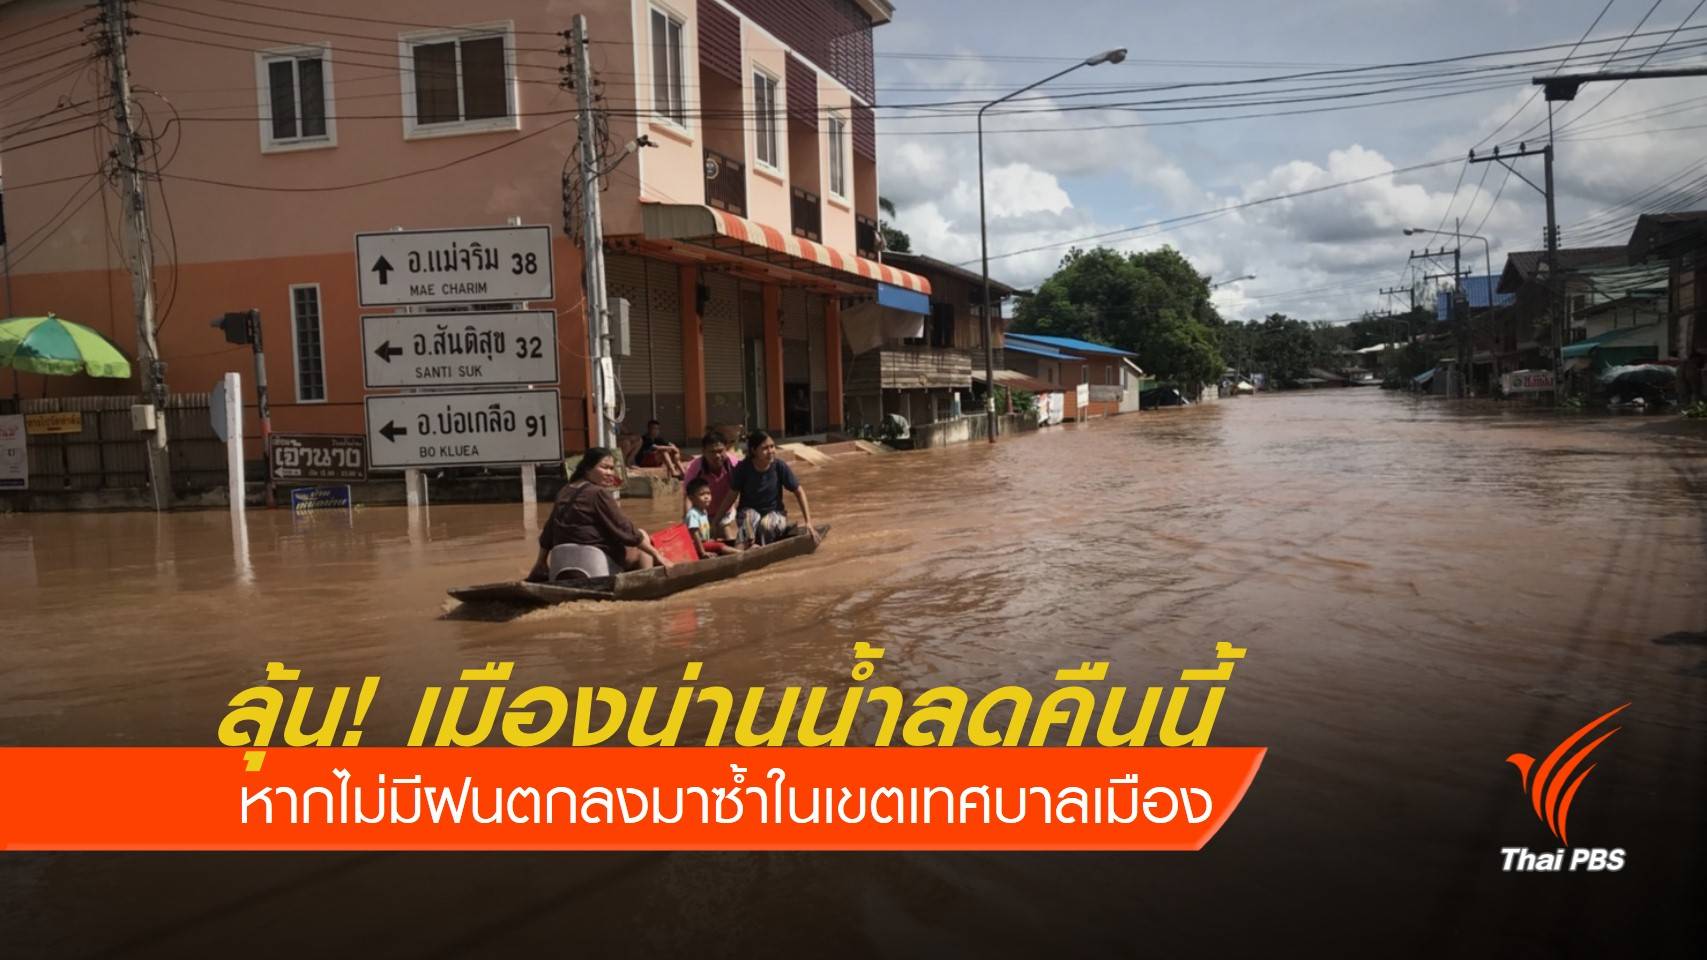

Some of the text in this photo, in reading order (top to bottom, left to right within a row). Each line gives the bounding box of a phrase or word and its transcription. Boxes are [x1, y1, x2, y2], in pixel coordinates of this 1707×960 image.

[408, 241, 538, 275] อ.แม่จริม 38
[410, 282, 487, 296] MAE CHARIM
[413, 324, 543, 361] อ.สันติสุข 32
[415, 365, 483, 379] SANTI SUK
[417, 403, 547, 438] อ.บ่อเกลือ 91
[419, 445, 479, 458] BO KLUEA
